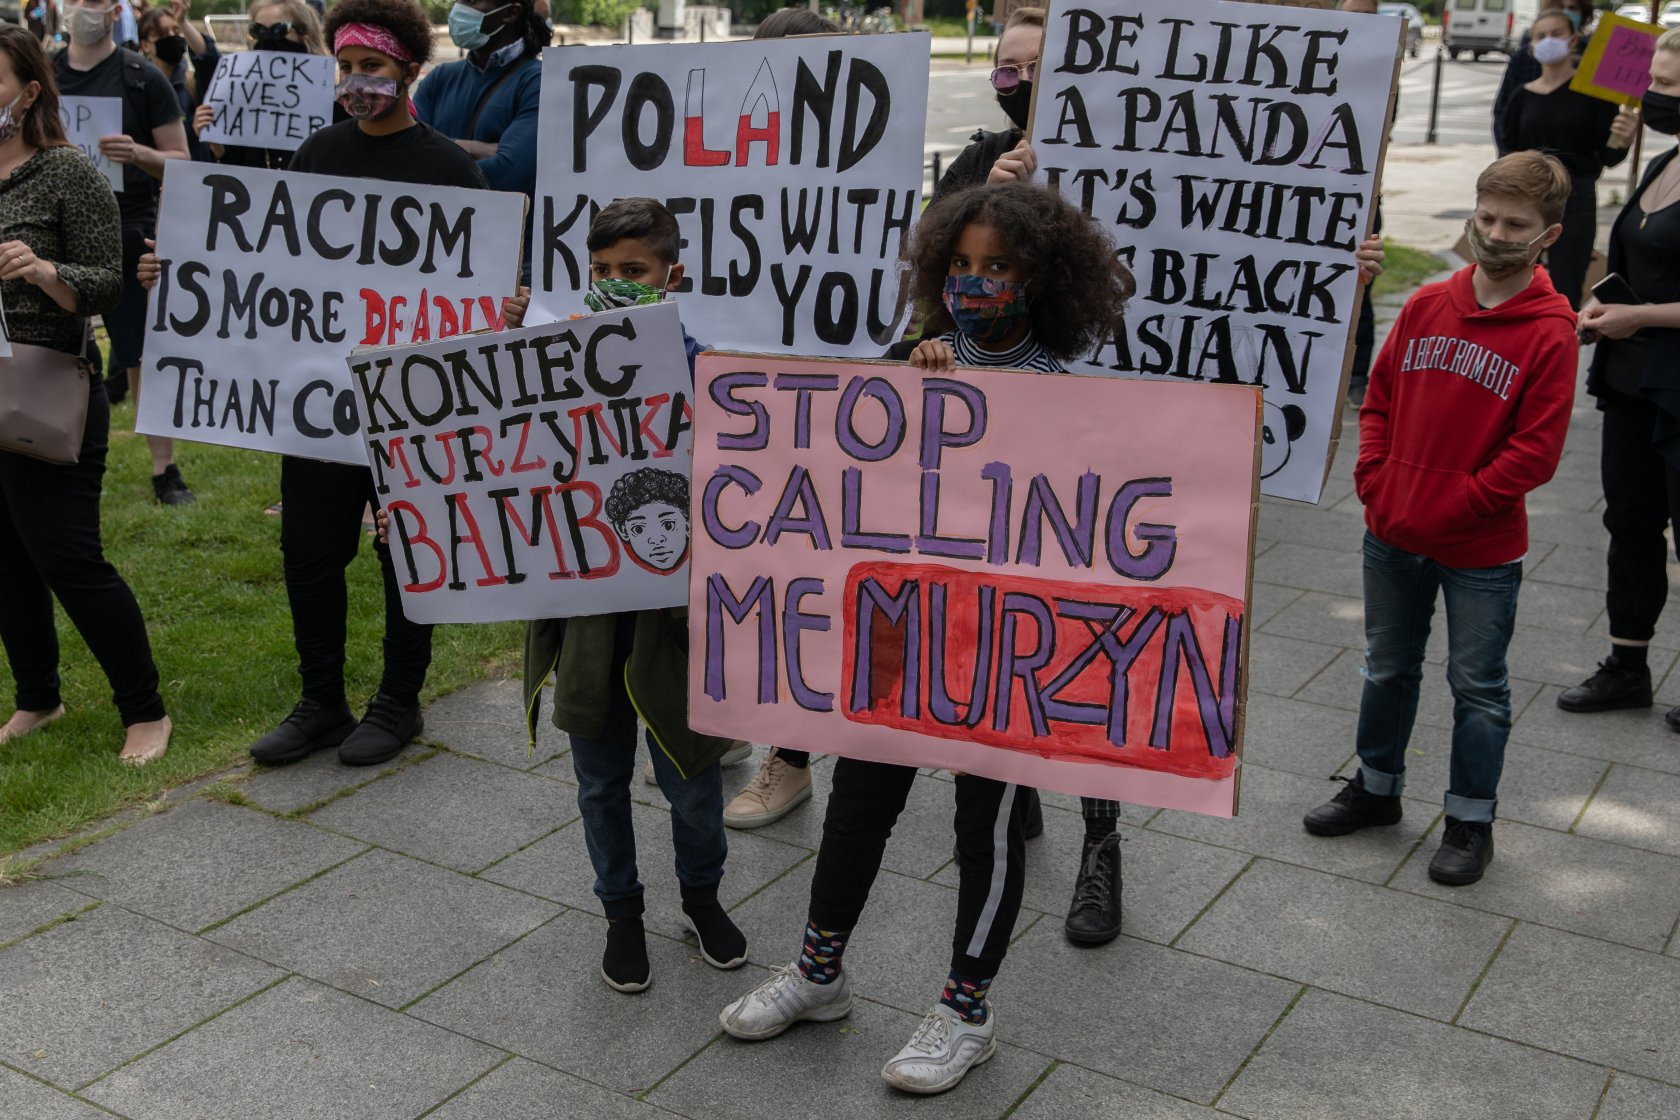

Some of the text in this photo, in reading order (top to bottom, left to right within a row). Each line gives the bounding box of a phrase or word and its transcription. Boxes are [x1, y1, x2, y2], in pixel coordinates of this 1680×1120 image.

[209, 80, 301, 109] LIVES
[216, 54, 314, 84] BLACK
[1053, 8, 1350, 97] BE LIKE
[206, 104, 325, 139] MATTER
[568, 49, 892, 174] POLAND
[1041, 85, 1373, 176] A PANDA
[202, 174, 476, 278] RACISM
[780, 186, 916, 259] WITH
[1172, 174, 1364, 252] WHITE
[152, 259, 210, 337] IS
[216, 268, 347, 343] MORE
[770, 263, 911, 347] YOU
[1142, 248, 1356, 325] BLACK
[1083, 313, 1325, 395] ASIAN
[1401, 336, 1520, 401] ABERCROMBIE
[156, 356, 280, 437] THAN
[708, 371, 988, 470] STOP
[369, 391, 693, 496] MURZYNKA
[701, 461, 1179, 581] CALLING
[703, 572, 1245, 759] ME MURZYN
